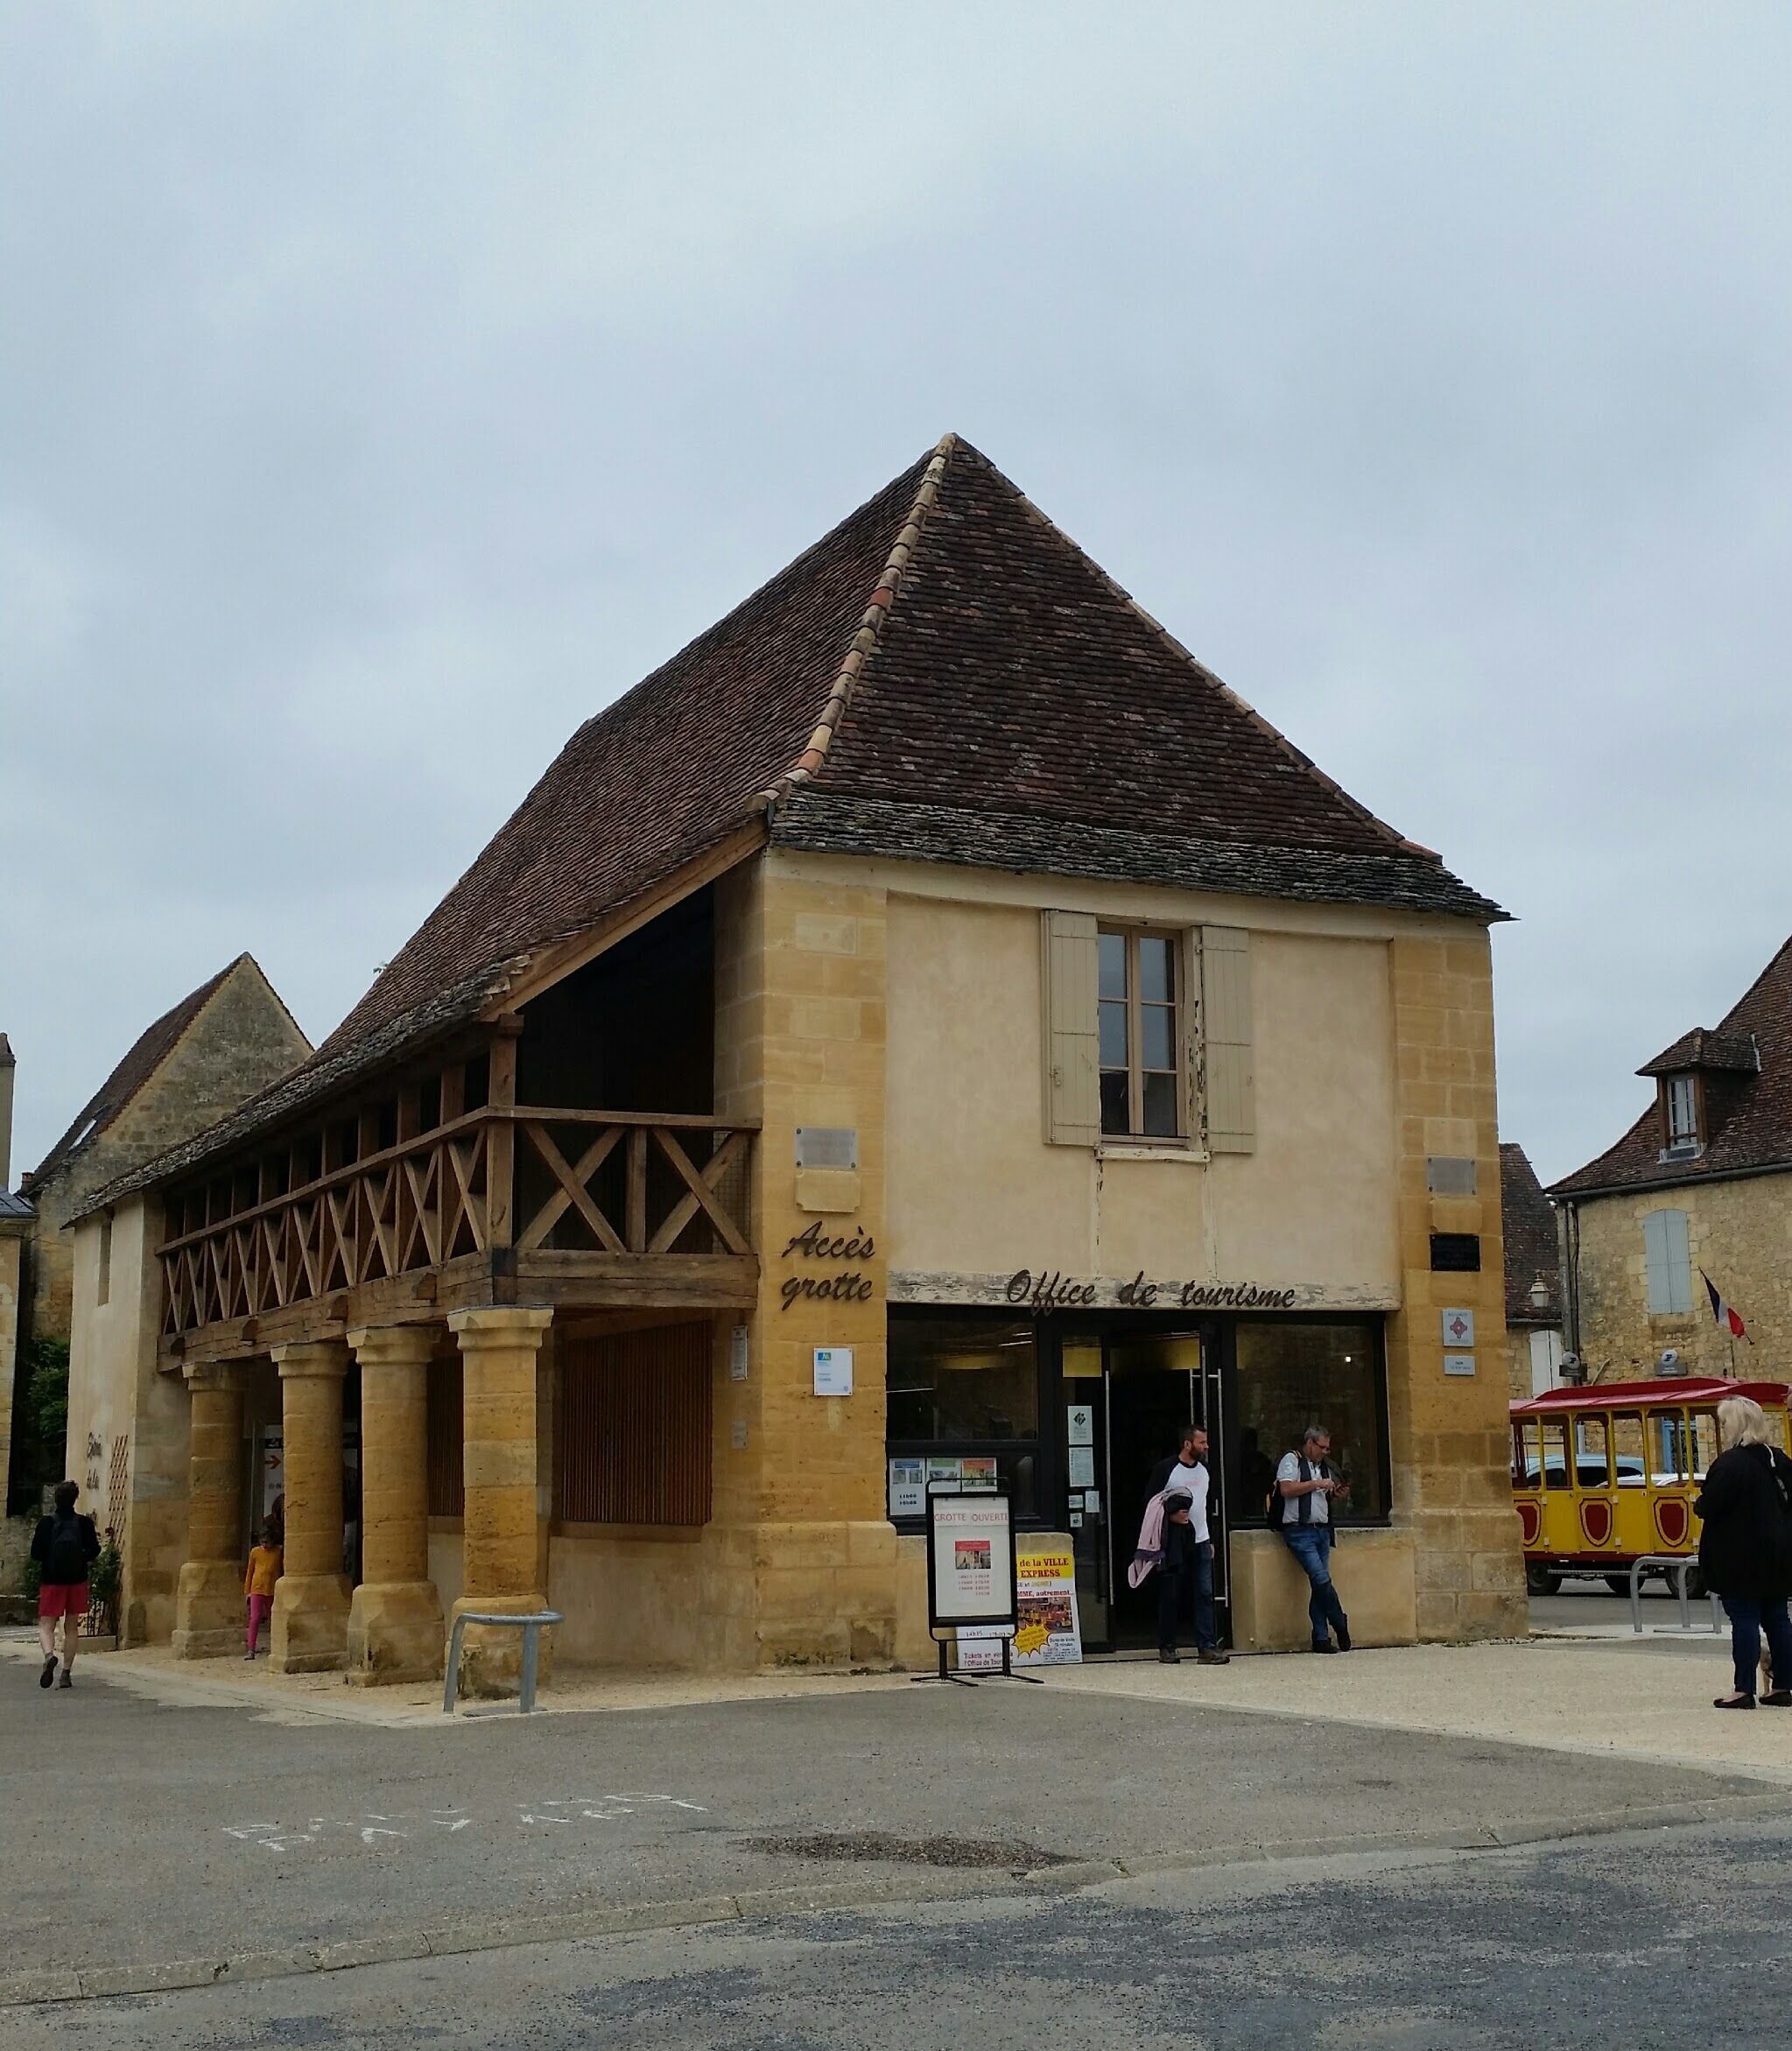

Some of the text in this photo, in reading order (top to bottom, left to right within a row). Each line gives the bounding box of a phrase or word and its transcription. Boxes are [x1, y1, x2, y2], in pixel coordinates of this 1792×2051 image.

[781, 1220, 875, 1260] Accès
[780, 1272, 873, 1311] grotte
[1006, 1268, 1297, 1316] Office de tourisme
[934, 1512, 1009, 1521] GROTTE OUVERTE
[1020, 1569, 1061, 1578] EXPRESS
[1033, 1558, 1042, 1567] la
[1043, 1557, 1069, 1567] VILLE
